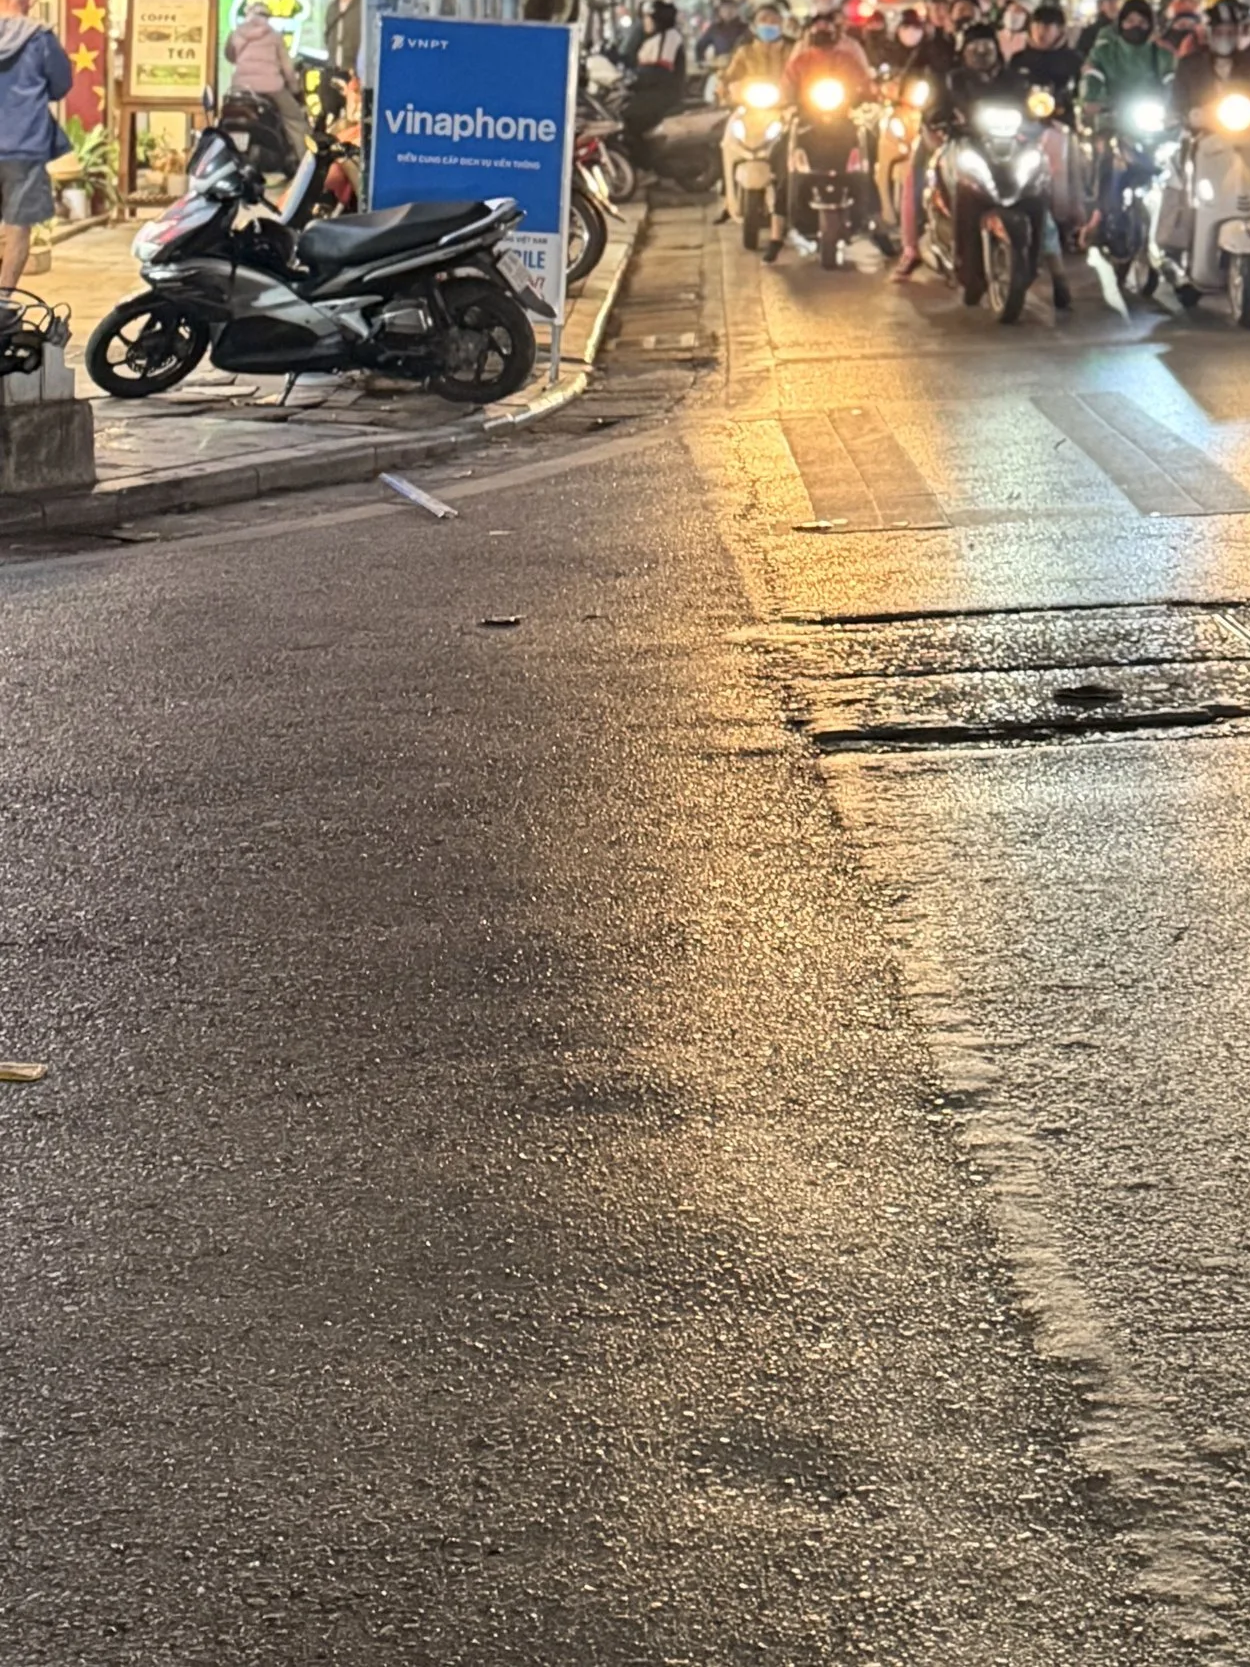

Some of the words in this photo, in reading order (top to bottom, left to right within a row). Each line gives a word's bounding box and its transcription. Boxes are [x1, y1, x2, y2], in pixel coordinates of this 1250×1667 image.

[407, 38, 449, 50] VNPT
[168, 47, 196, 60] TEA
[385, 103, 557, 142] vinaphone
